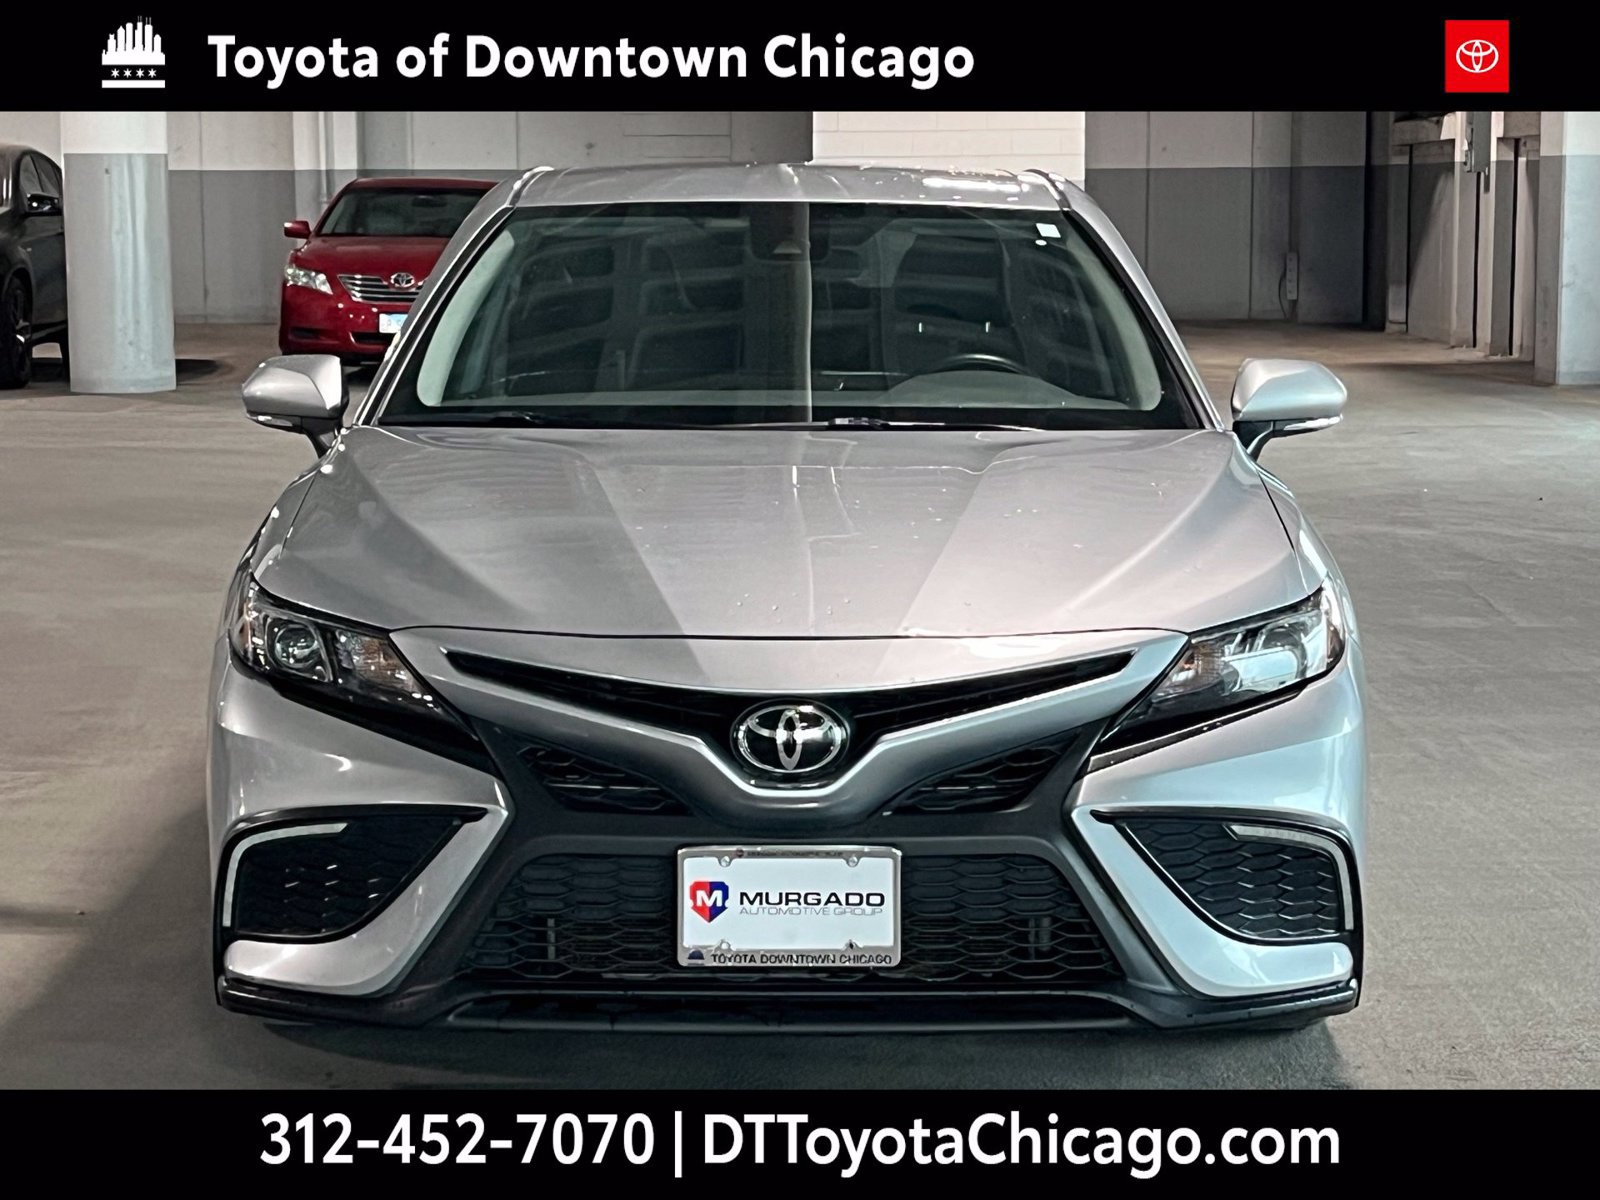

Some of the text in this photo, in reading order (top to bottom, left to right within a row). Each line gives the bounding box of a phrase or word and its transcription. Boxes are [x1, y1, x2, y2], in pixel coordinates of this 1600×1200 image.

[696, 889, 723, 907] M
[740, 891, 885, 907] MURGADO
[740, 906, 883, 916] AUTOMOTIVE GROUP
[711, 953, 892, 965] TOYOTA DOWNTOWN CHICAGO
